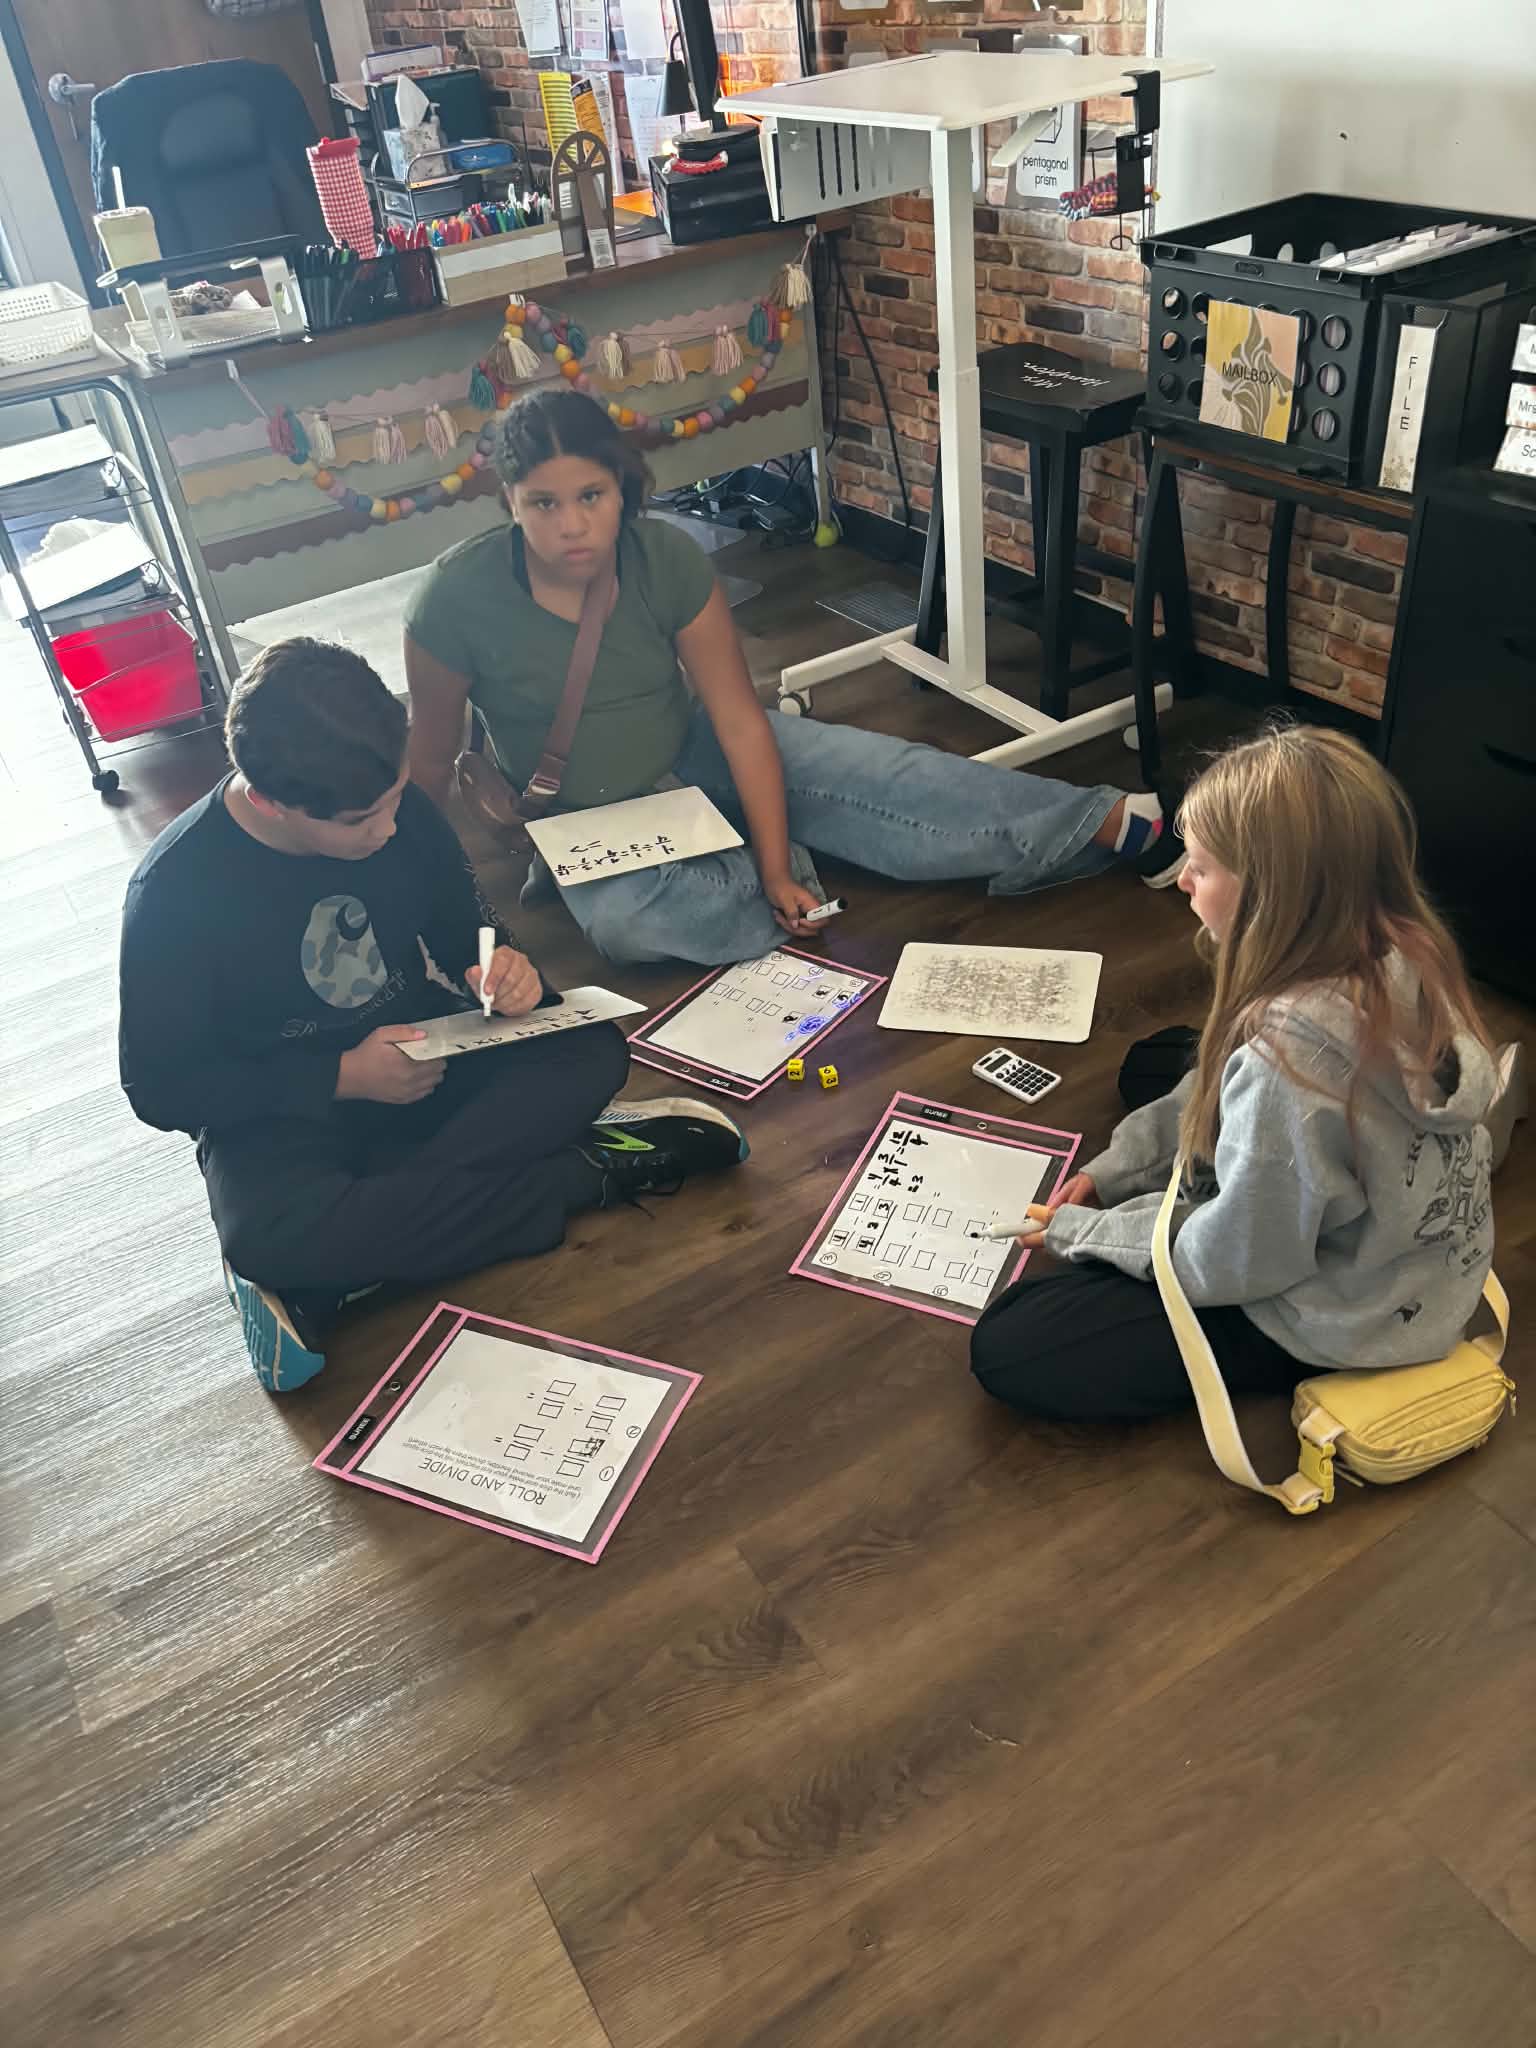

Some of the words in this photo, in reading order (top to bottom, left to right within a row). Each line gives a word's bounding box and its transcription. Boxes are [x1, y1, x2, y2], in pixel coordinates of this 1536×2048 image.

[1022, 156, 1069, 172] pentagonal
[1034, 175, 1057, 189] prism
[1221, 361, 1278, 385] MAILBOX
[1400, 356, 1418, 430] FILE
[418, 1458, 470, 1481] DIVIDE
[470, 1474, 505, 1491] AND
[509, 1483, 547, 1505] ROLL
